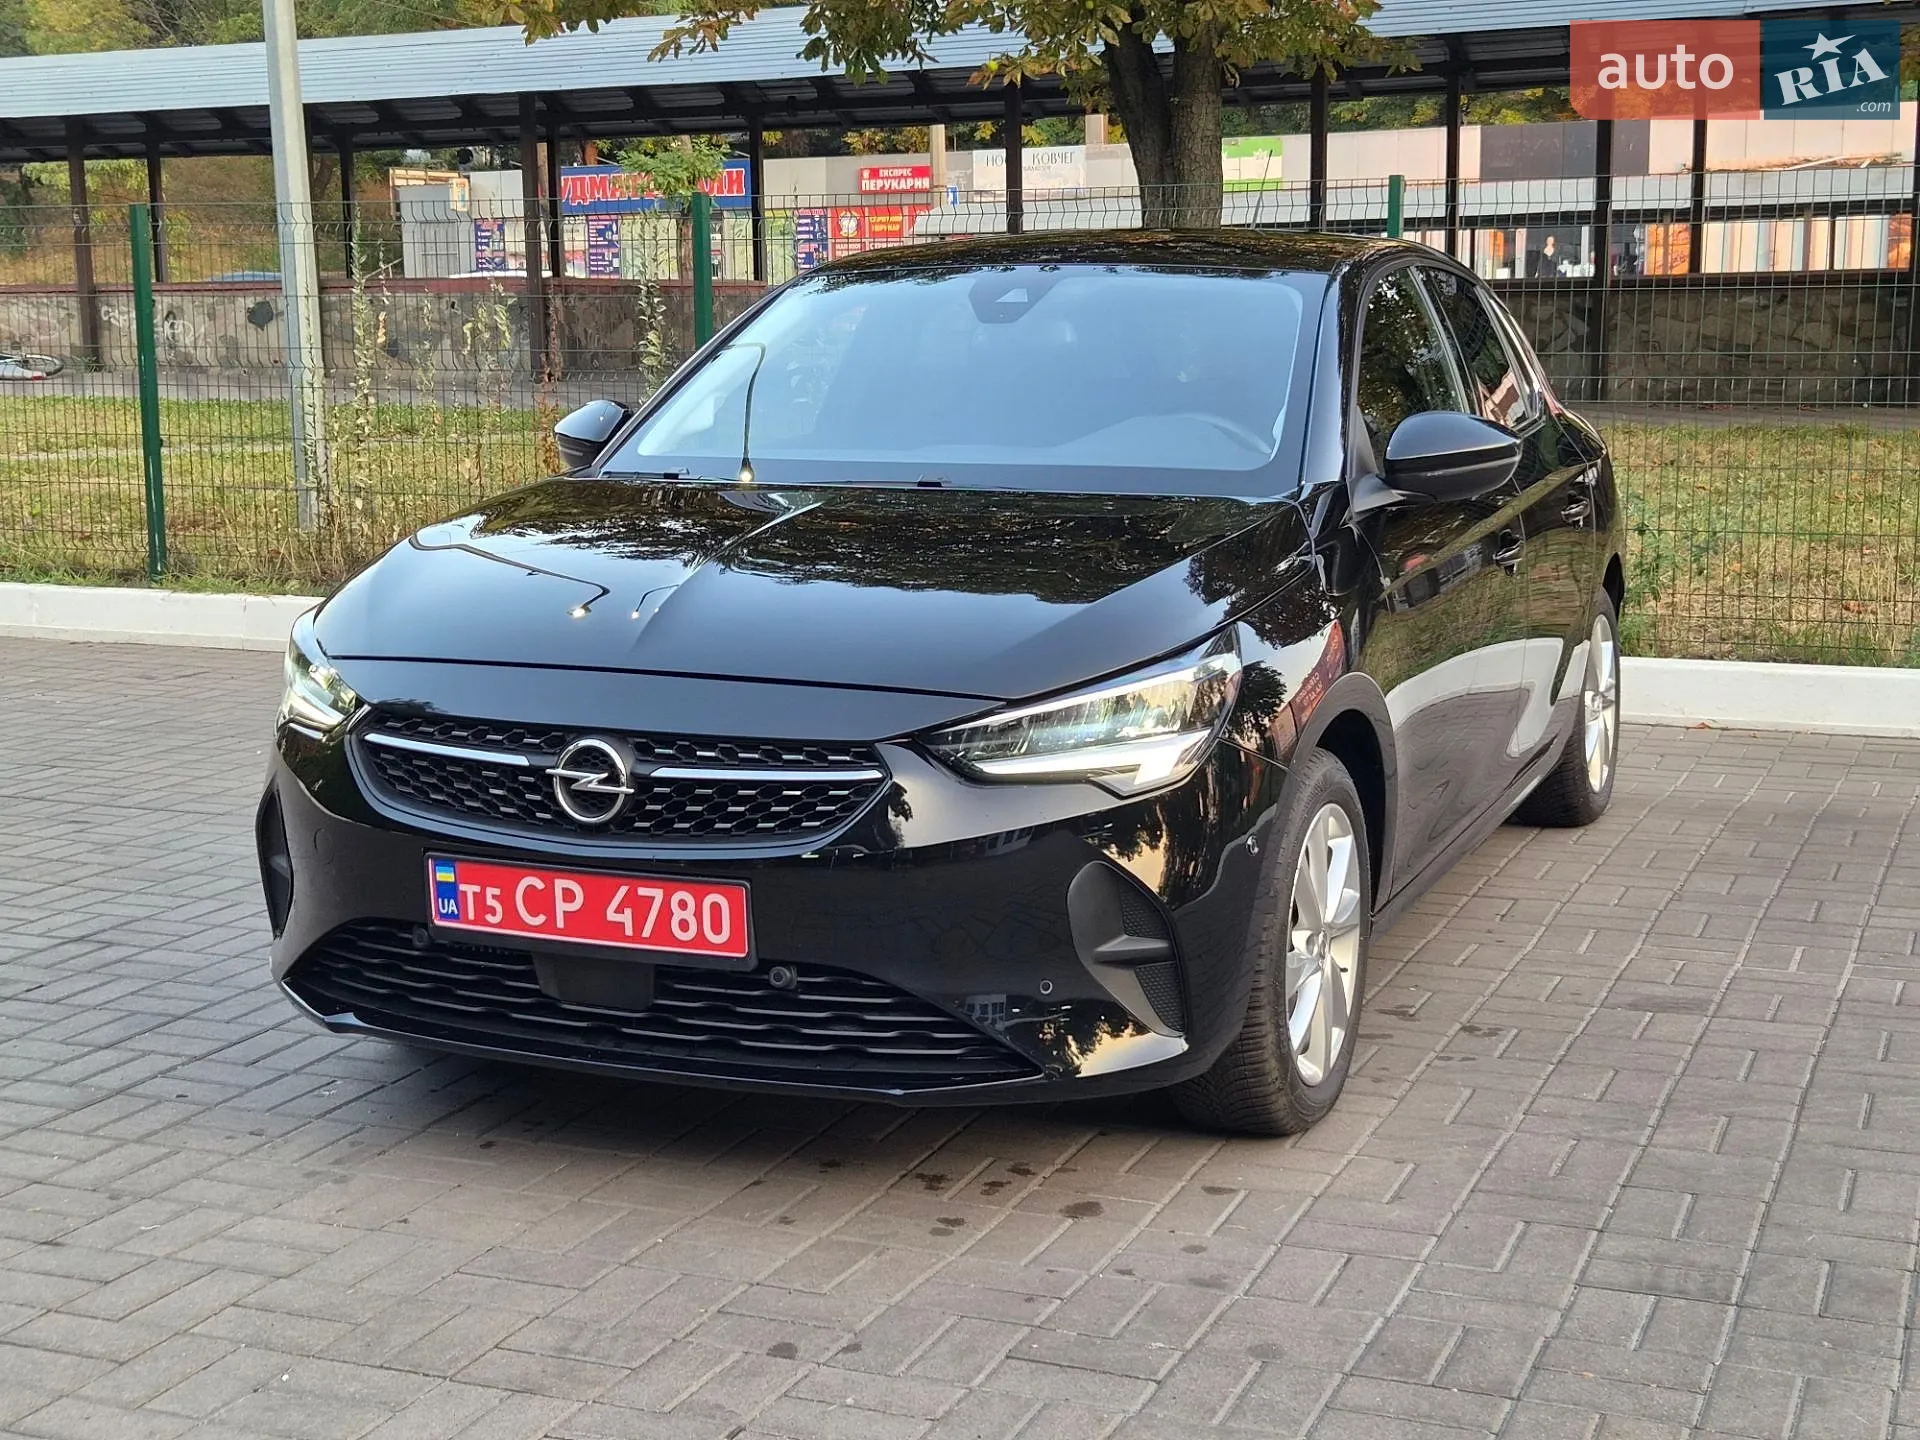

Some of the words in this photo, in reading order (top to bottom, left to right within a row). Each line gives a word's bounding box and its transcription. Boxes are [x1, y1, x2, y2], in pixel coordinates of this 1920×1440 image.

[861, 177, 930, 191] ПЕРУКАРНЯ
[438, 897, 458, 916] UA
[459, 884, 503, 924] T5
[514, 876, 584, 929] CP
[605, 884, 731, 944] 4780
